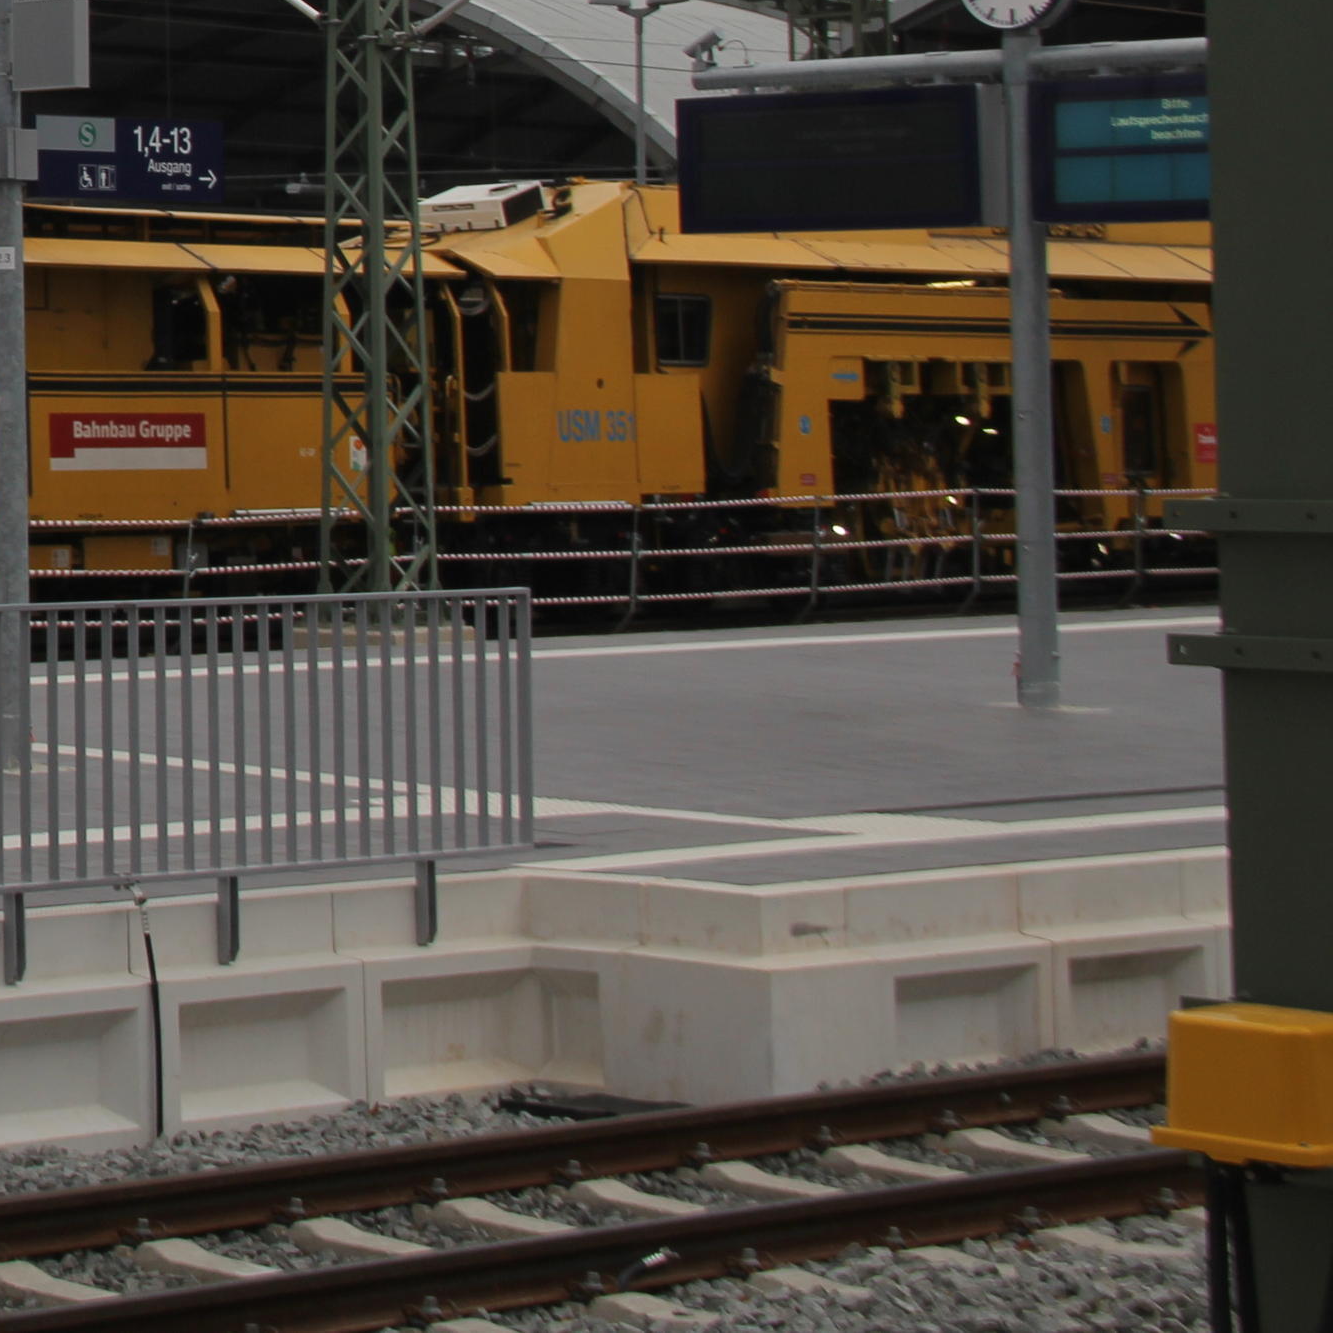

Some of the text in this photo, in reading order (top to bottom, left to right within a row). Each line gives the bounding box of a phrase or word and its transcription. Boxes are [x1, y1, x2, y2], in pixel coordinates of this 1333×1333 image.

[81, 125, 95, 149] S
[133, 125, 192, 157] 1,4-13
[147, 159, 192, 177] Ausgang
[73, 420, 192, 443] Bahnbau Gruppe
[557, 410, 636, 443] USM 351
